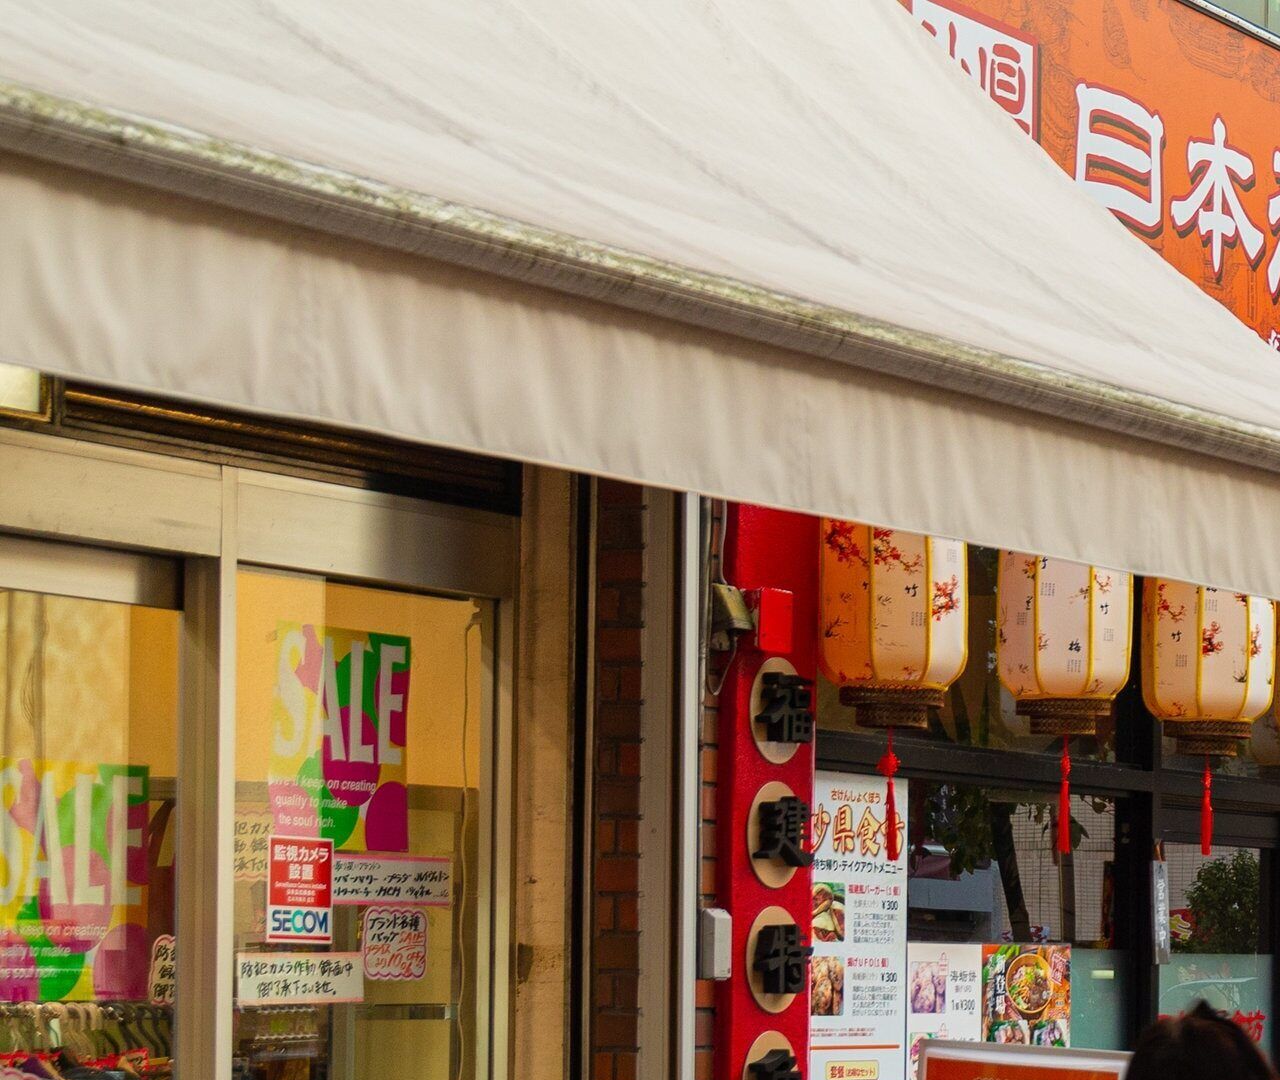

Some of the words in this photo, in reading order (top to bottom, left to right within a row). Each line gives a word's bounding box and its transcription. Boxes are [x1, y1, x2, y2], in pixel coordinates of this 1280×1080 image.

[272, 629, 407, 765] SALE
[327, 781, 340, 790] on
[341, 780, 377, 794] creating
[275, 795, 308, 809] quality
[321, 798, 348, 810] make
[279, 813, 292, 825] the
[293, 814, 313, 827] soul
[0, 766, 143, 906] SALE
[273, 844, 330, 863] 監視カメラ
[288, 864, 314, 881] 設置
[881, 900, 899, 911] ¥300
[271, 909, 329, 935] SECOM
[881, 972, 898, 983] ¥300
